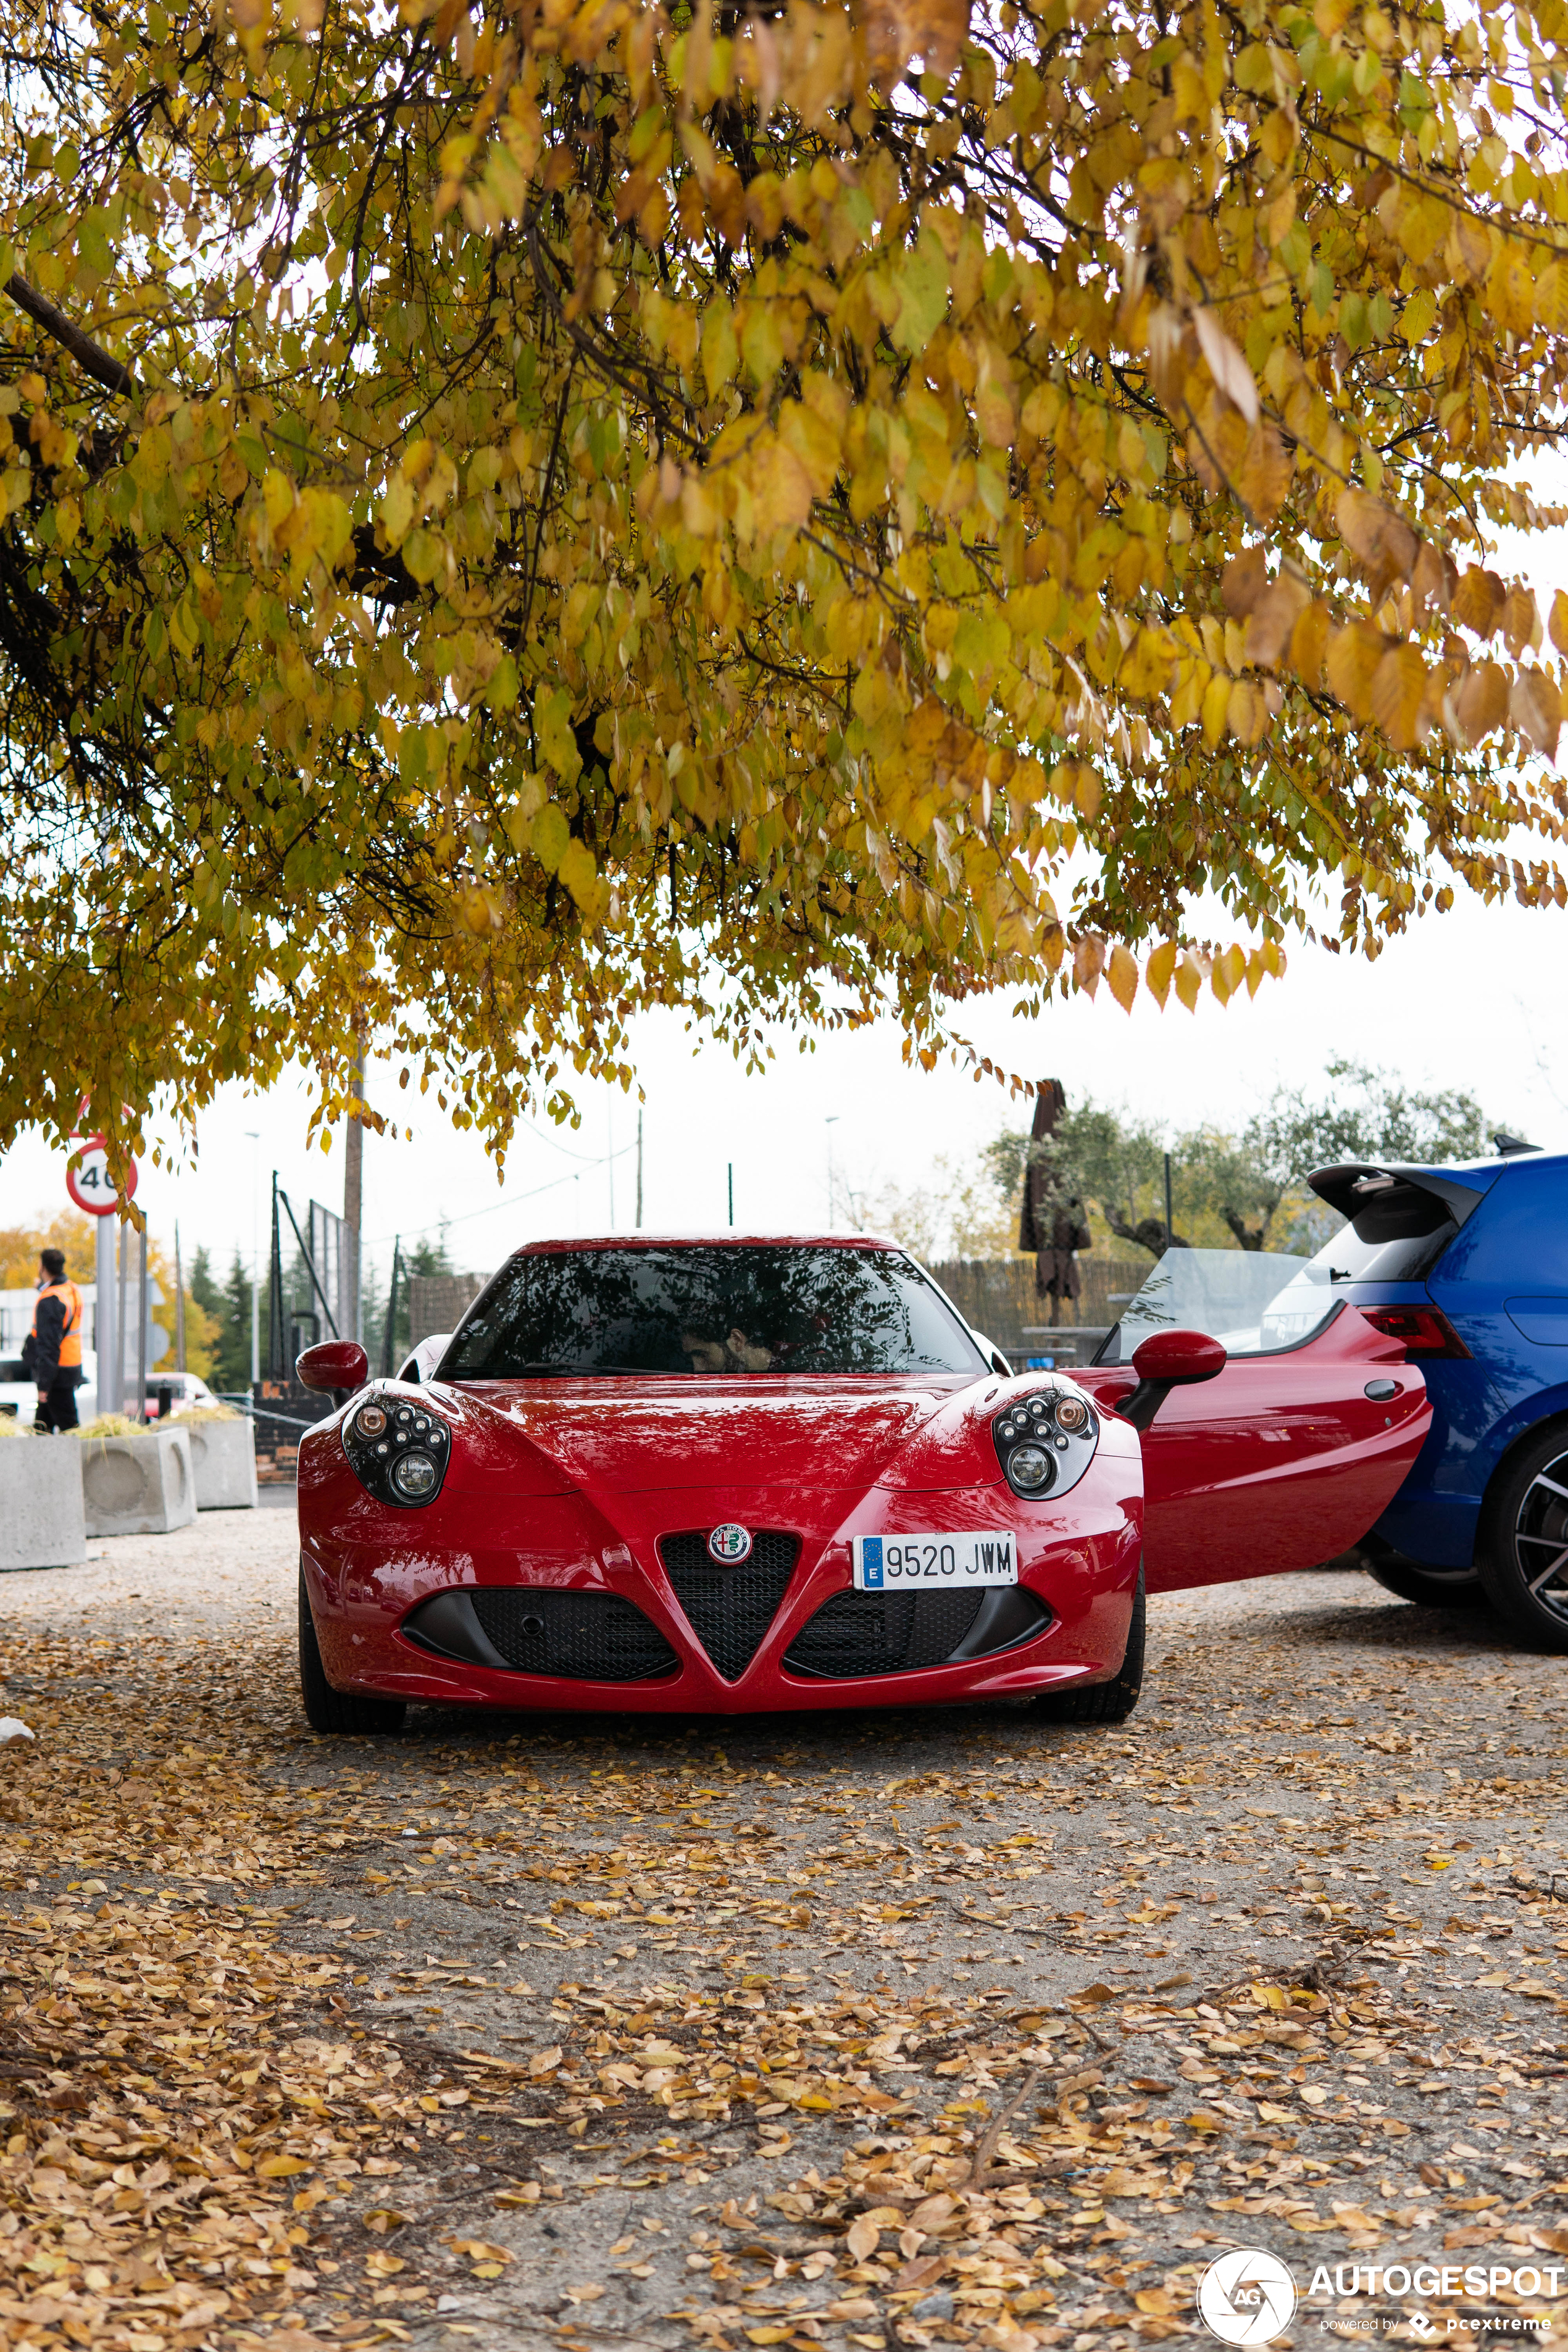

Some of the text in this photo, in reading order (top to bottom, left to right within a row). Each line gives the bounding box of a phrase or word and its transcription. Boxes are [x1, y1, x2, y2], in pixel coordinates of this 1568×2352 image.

[712, 1526, 747, 1543] ALFA ROMEO
[887, 1543, 1011, 1577] 9520 JWM
[869, 1568, 878, 1579] E
